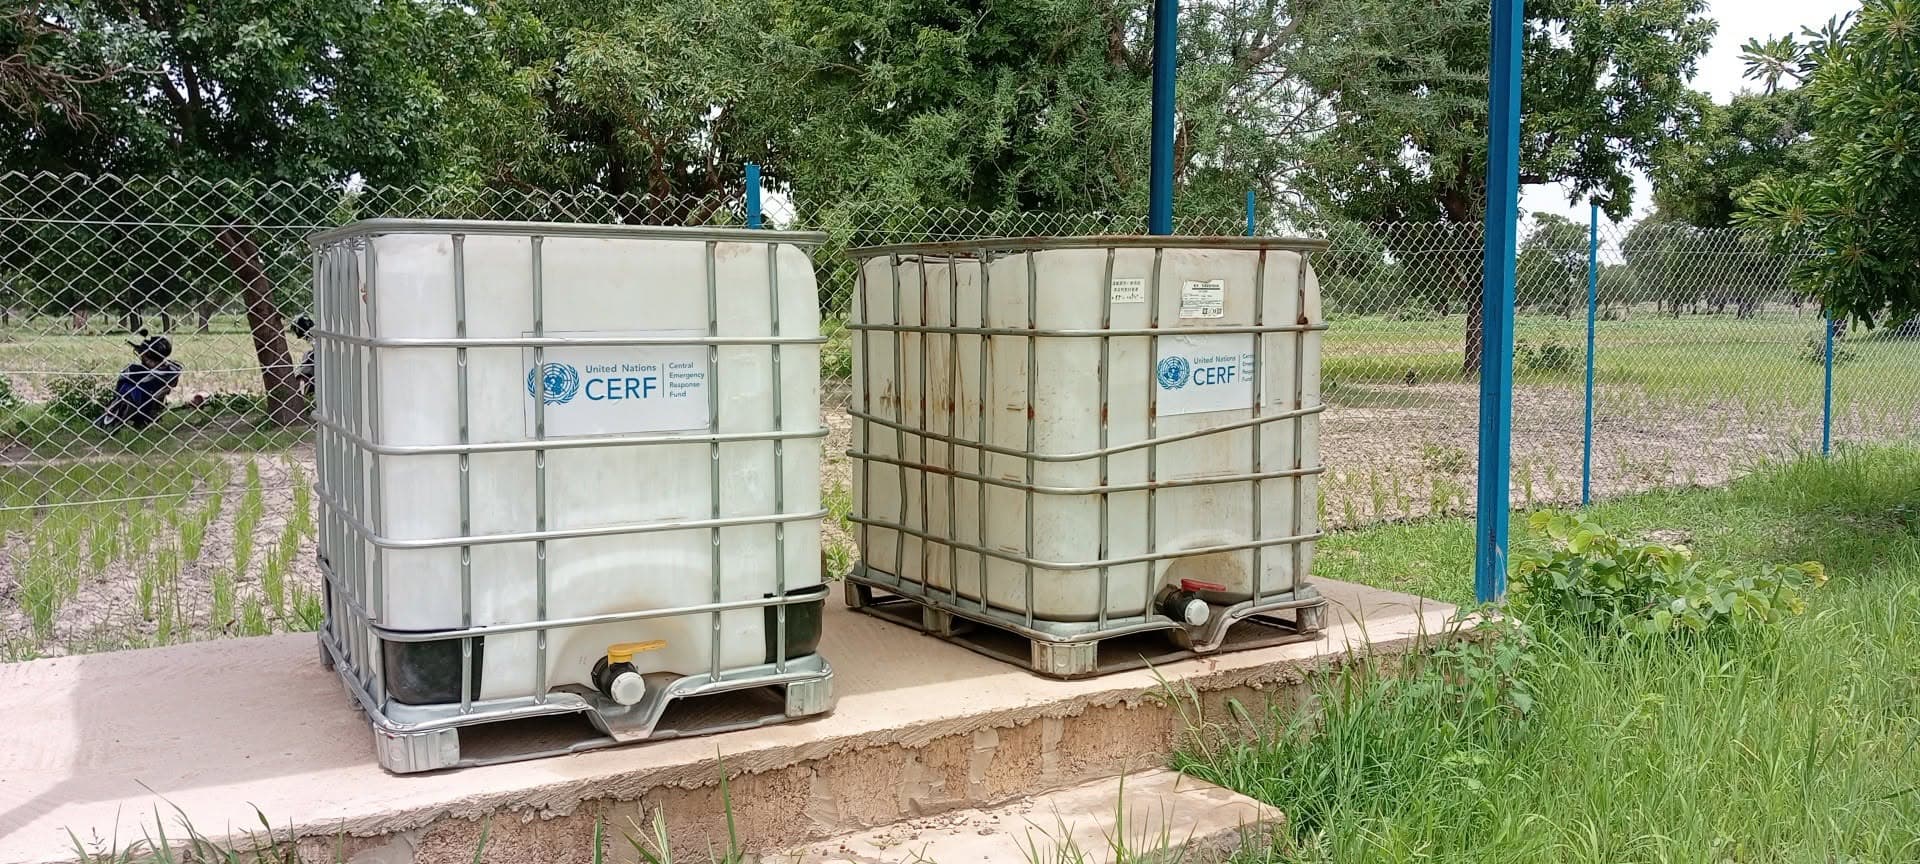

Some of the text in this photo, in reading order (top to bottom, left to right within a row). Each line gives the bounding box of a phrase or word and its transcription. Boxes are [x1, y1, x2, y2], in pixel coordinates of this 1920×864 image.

[1194, 354, 1236, 364] United Nations
[585, 364, 657, 374] United Nations
[669, 372, 705, 380] Emergency
[1193, 365, 1236, 386] CERF
[585, 377, 657, 401] CERF
[669, 390, 687, 398] Fund
